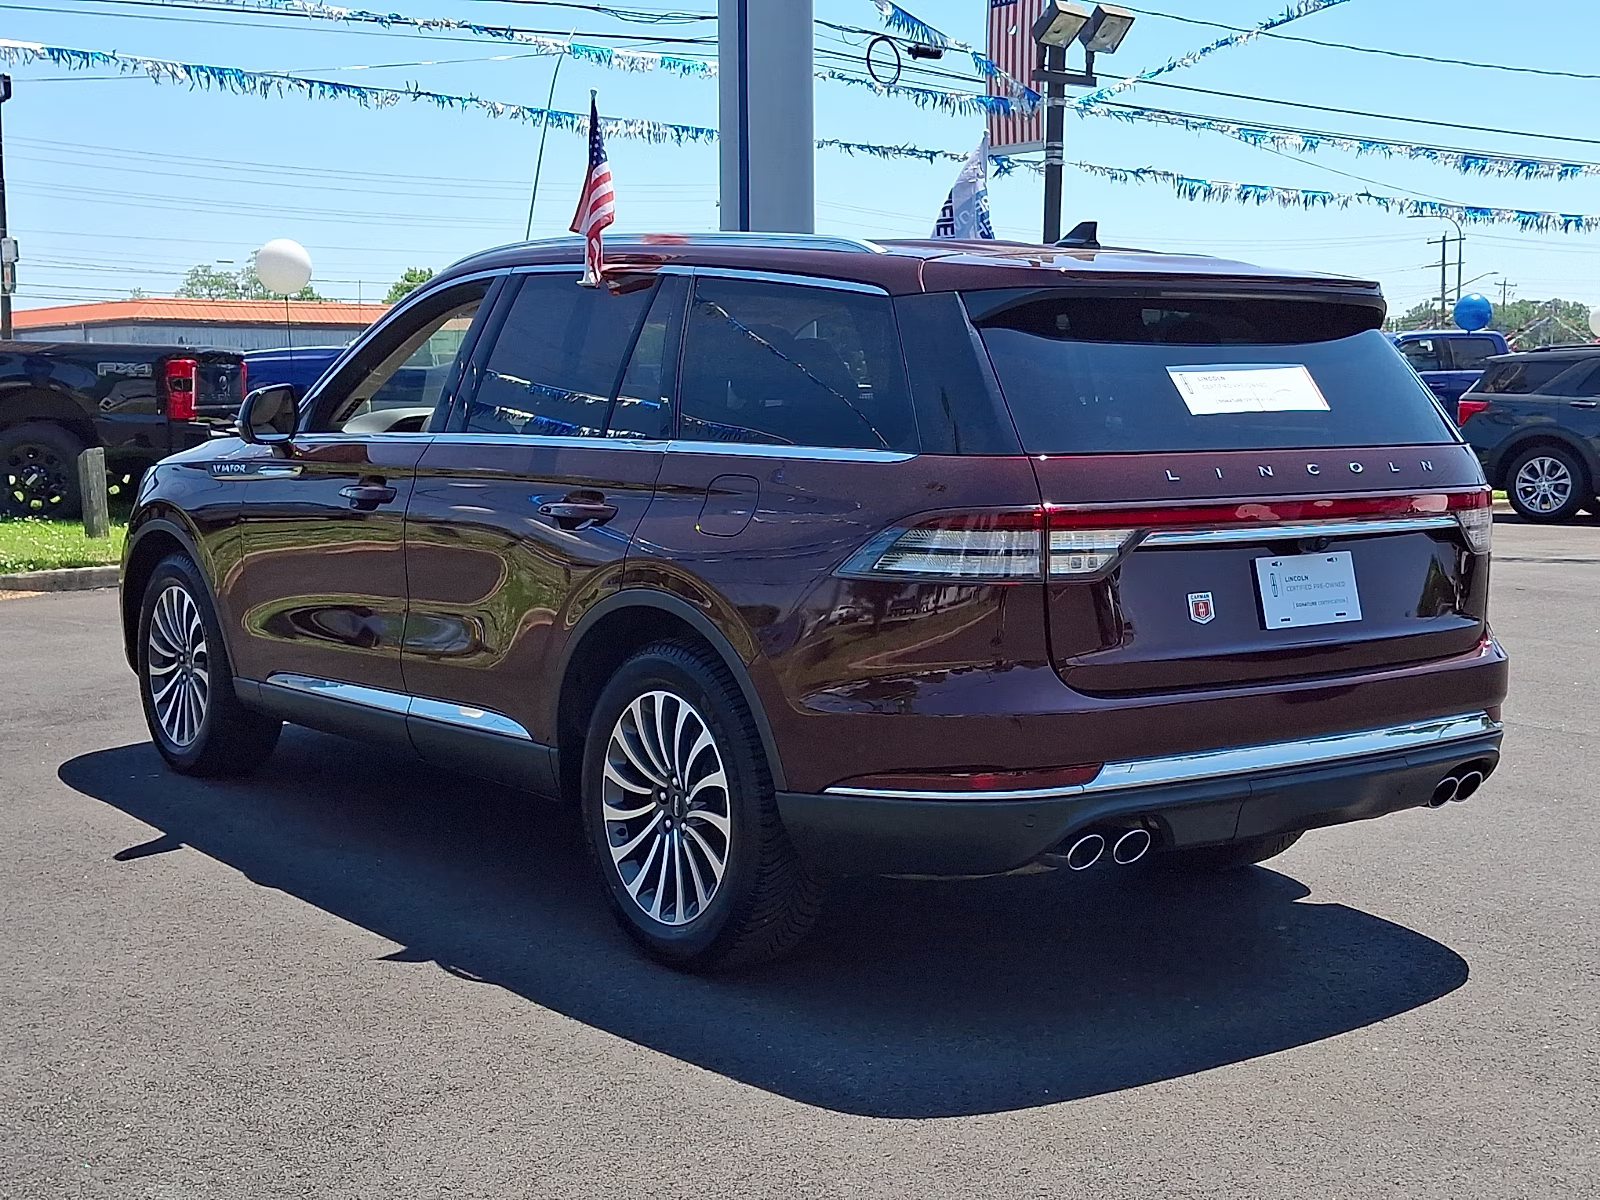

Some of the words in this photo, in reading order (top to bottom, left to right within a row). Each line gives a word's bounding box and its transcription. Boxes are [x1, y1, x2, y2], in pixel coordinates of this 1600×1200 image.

[97, 362, 152, 377] FX4
[1165, 460, 1434, 482] LINCOLN
[1284, 575, 1309, 583] LINCOLN
[1286, 584, 1312, 592] CERTIFIED
[1313, 581, 1346, 590] PRE-OWNED
